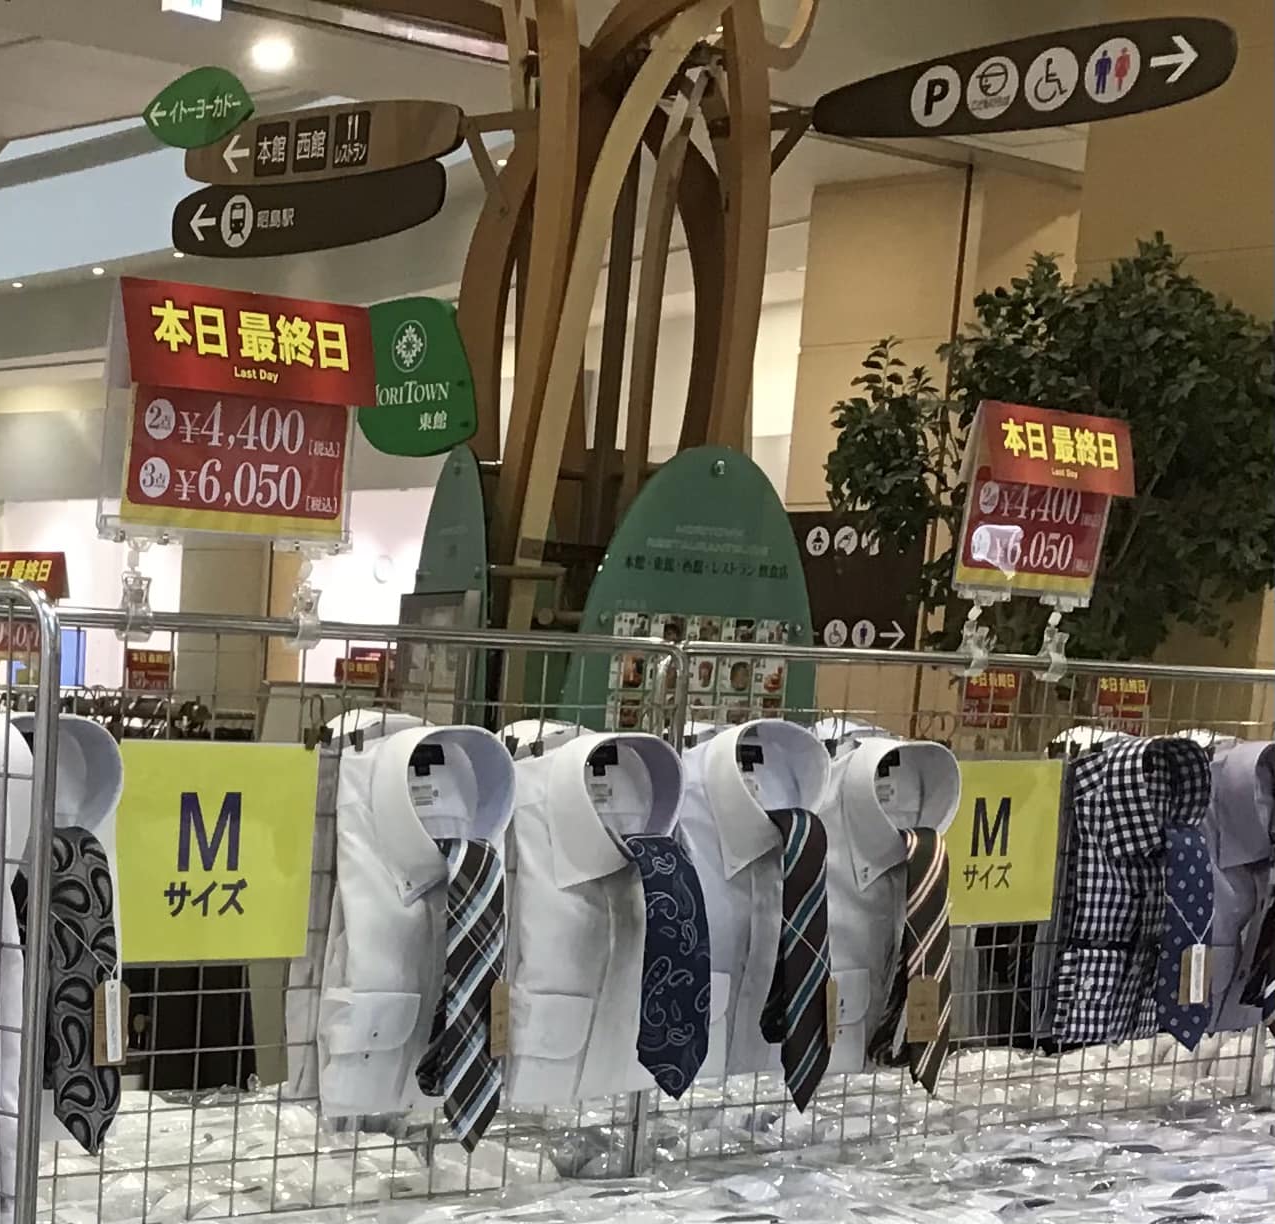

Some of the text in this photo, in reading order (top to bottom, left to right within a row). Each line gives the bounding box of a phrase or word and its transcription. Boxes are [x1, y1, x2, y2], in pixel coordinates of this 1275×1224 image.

[170, 95, 241, 124] イトーヨーカドー
[924, 78, 949, 116] P
[258, 130, 366, 164] 本館 西館 レストラン
[151, 300, 349, 371] 本日 最終日
[234, 367, 279, 383] Last Day
[180, 401, 305, 454] ¥4,400
[418, 410, 447, 431] 東館
[1002, 418, 1119, 470] 本日 最終日
[175, 459, 301, 510] ¥6,050
[178, 792, 242, 872] M
[971, 797, 1012, 857] M
[963, 862, 1012, 890] サイズ
[164, 878, 248, 917] サイズ
